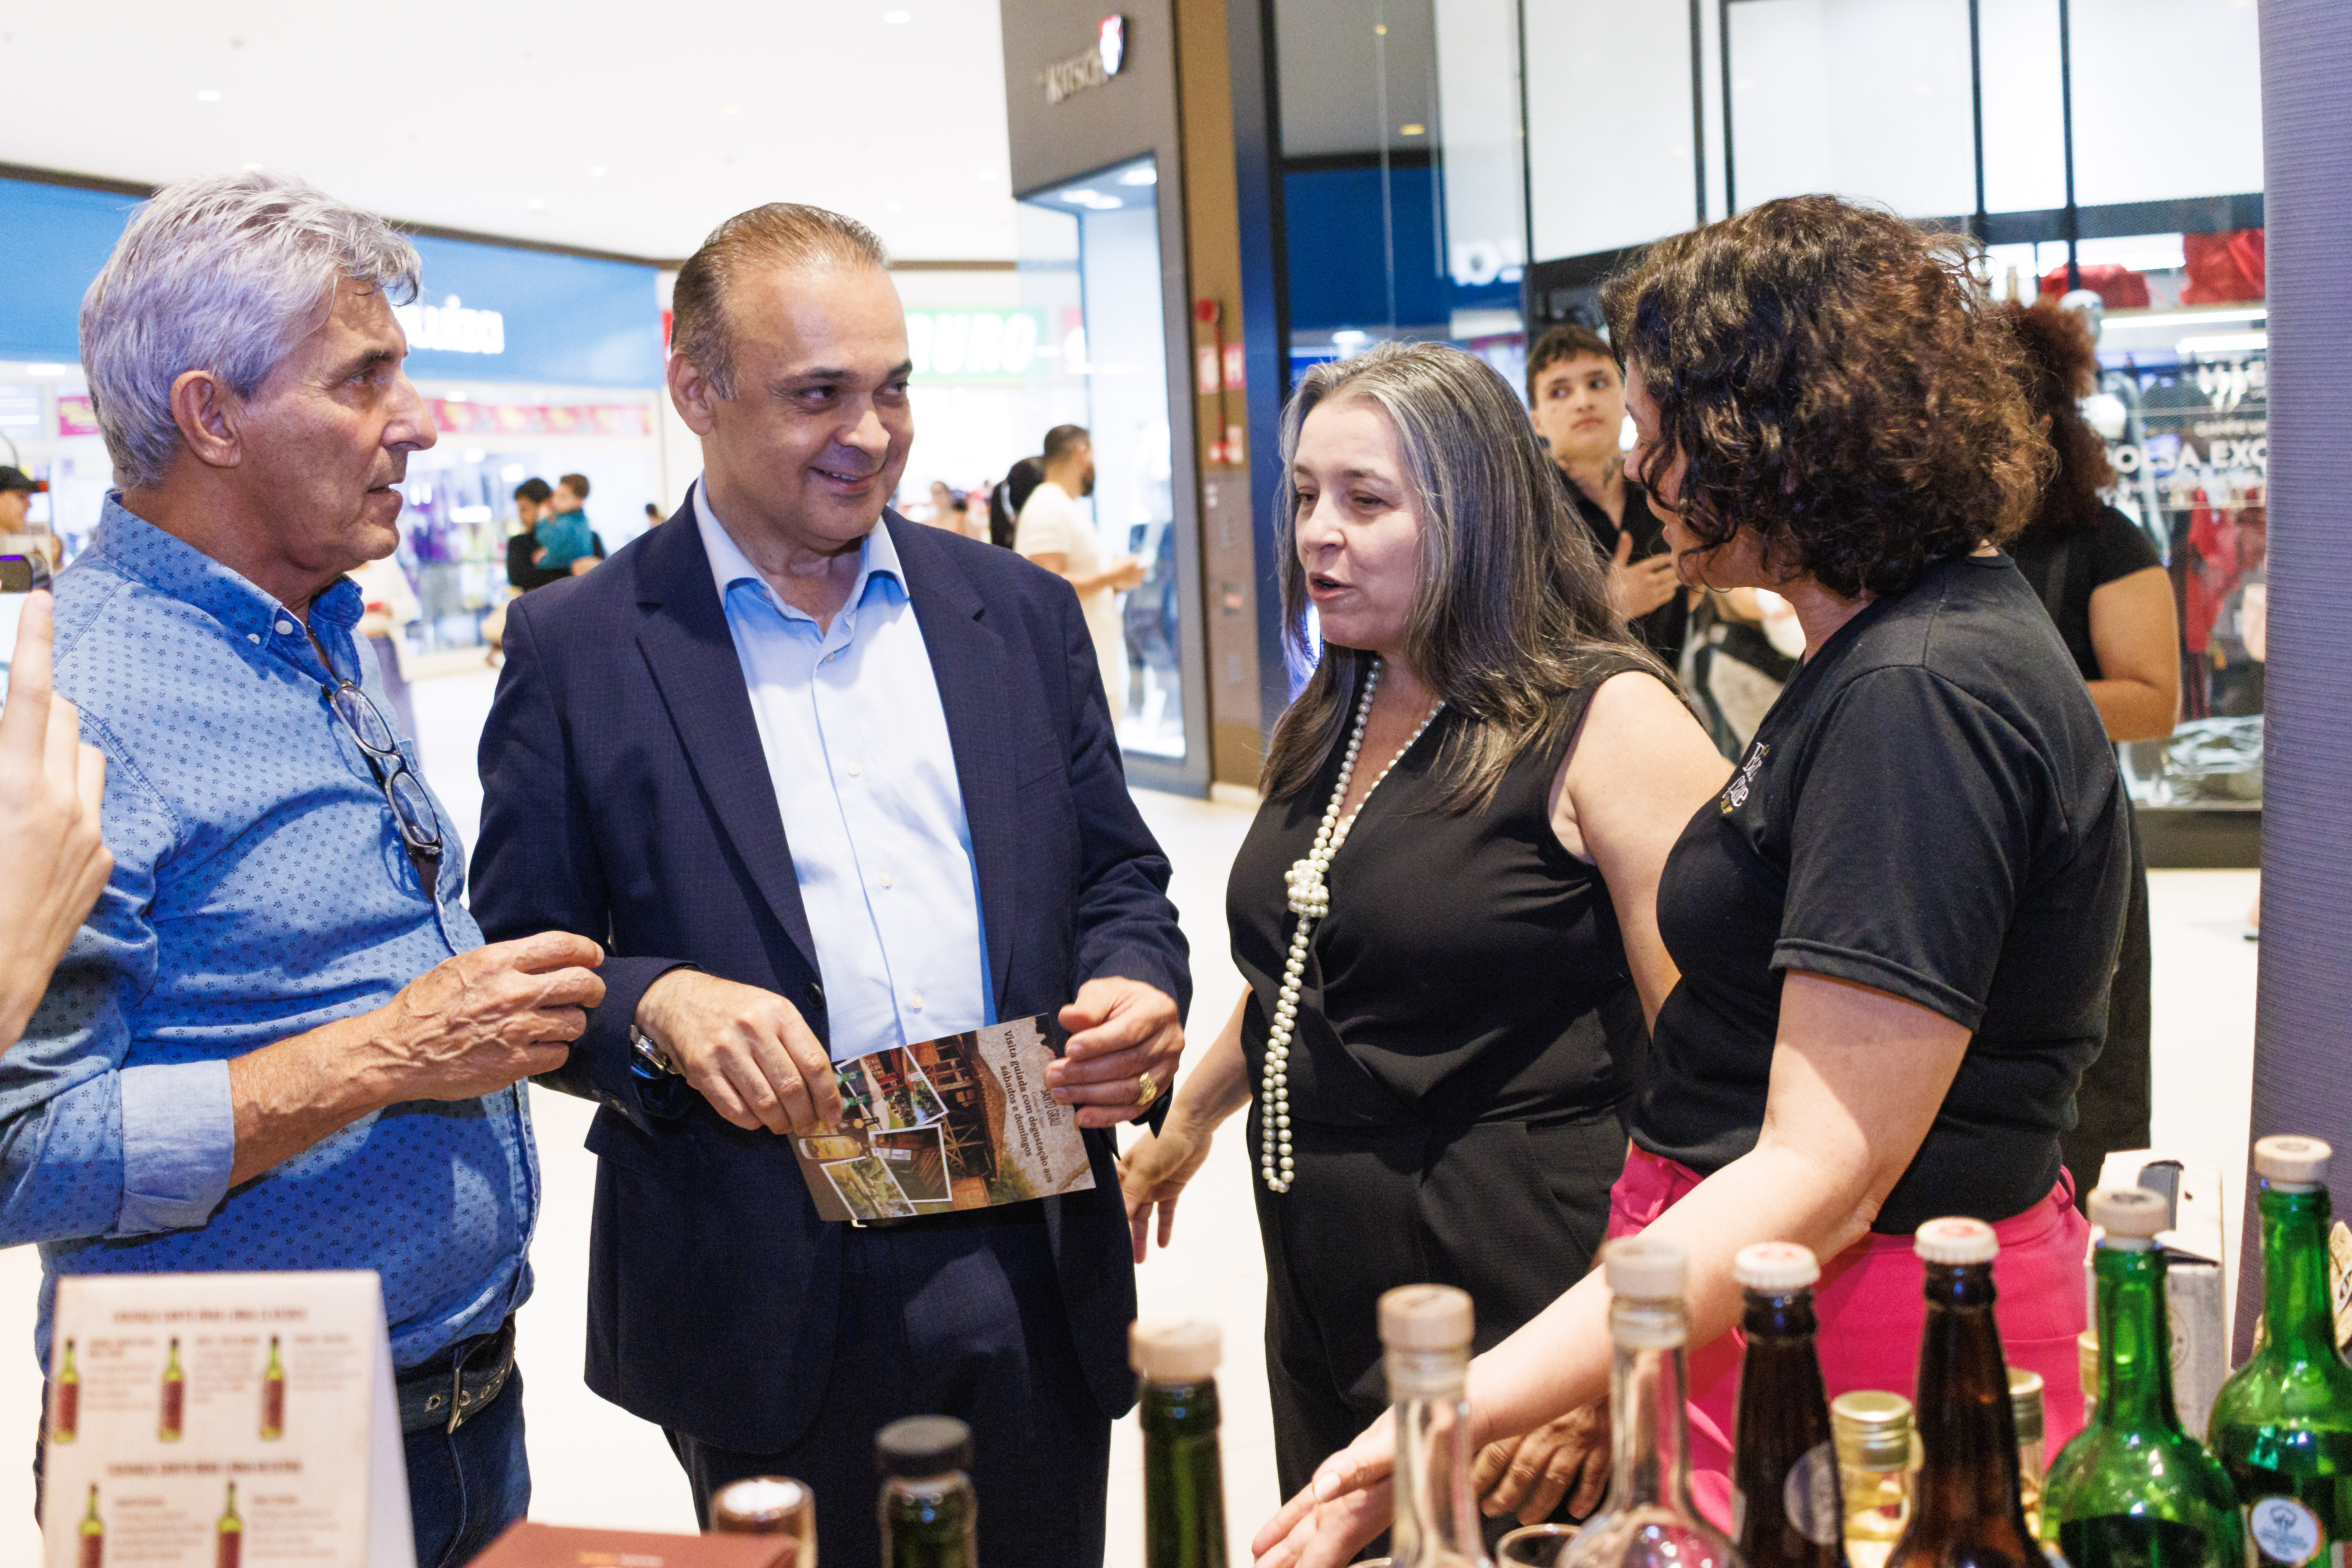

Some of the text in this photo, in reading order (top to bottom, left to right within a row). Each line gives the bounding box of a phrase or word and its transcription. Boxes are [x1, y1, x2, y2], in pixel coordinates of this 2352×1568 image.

[2106, 443, 2200, 473] OLSA
[1000, 1065, 1016, 1104] sábados
[1014, 1113, 1032, 1157] domingos
[1004, 1030, 1016, 1058] Visita
[1010, 1060, 1027, 1092] guiada
[1022, 1094, 1033, 1114] com
[1029, 1116, 1049, 1166] degustação
[1044, 1168, 1053, 1183] aos
[1047, 1106, 1063, 1127] GRAU
